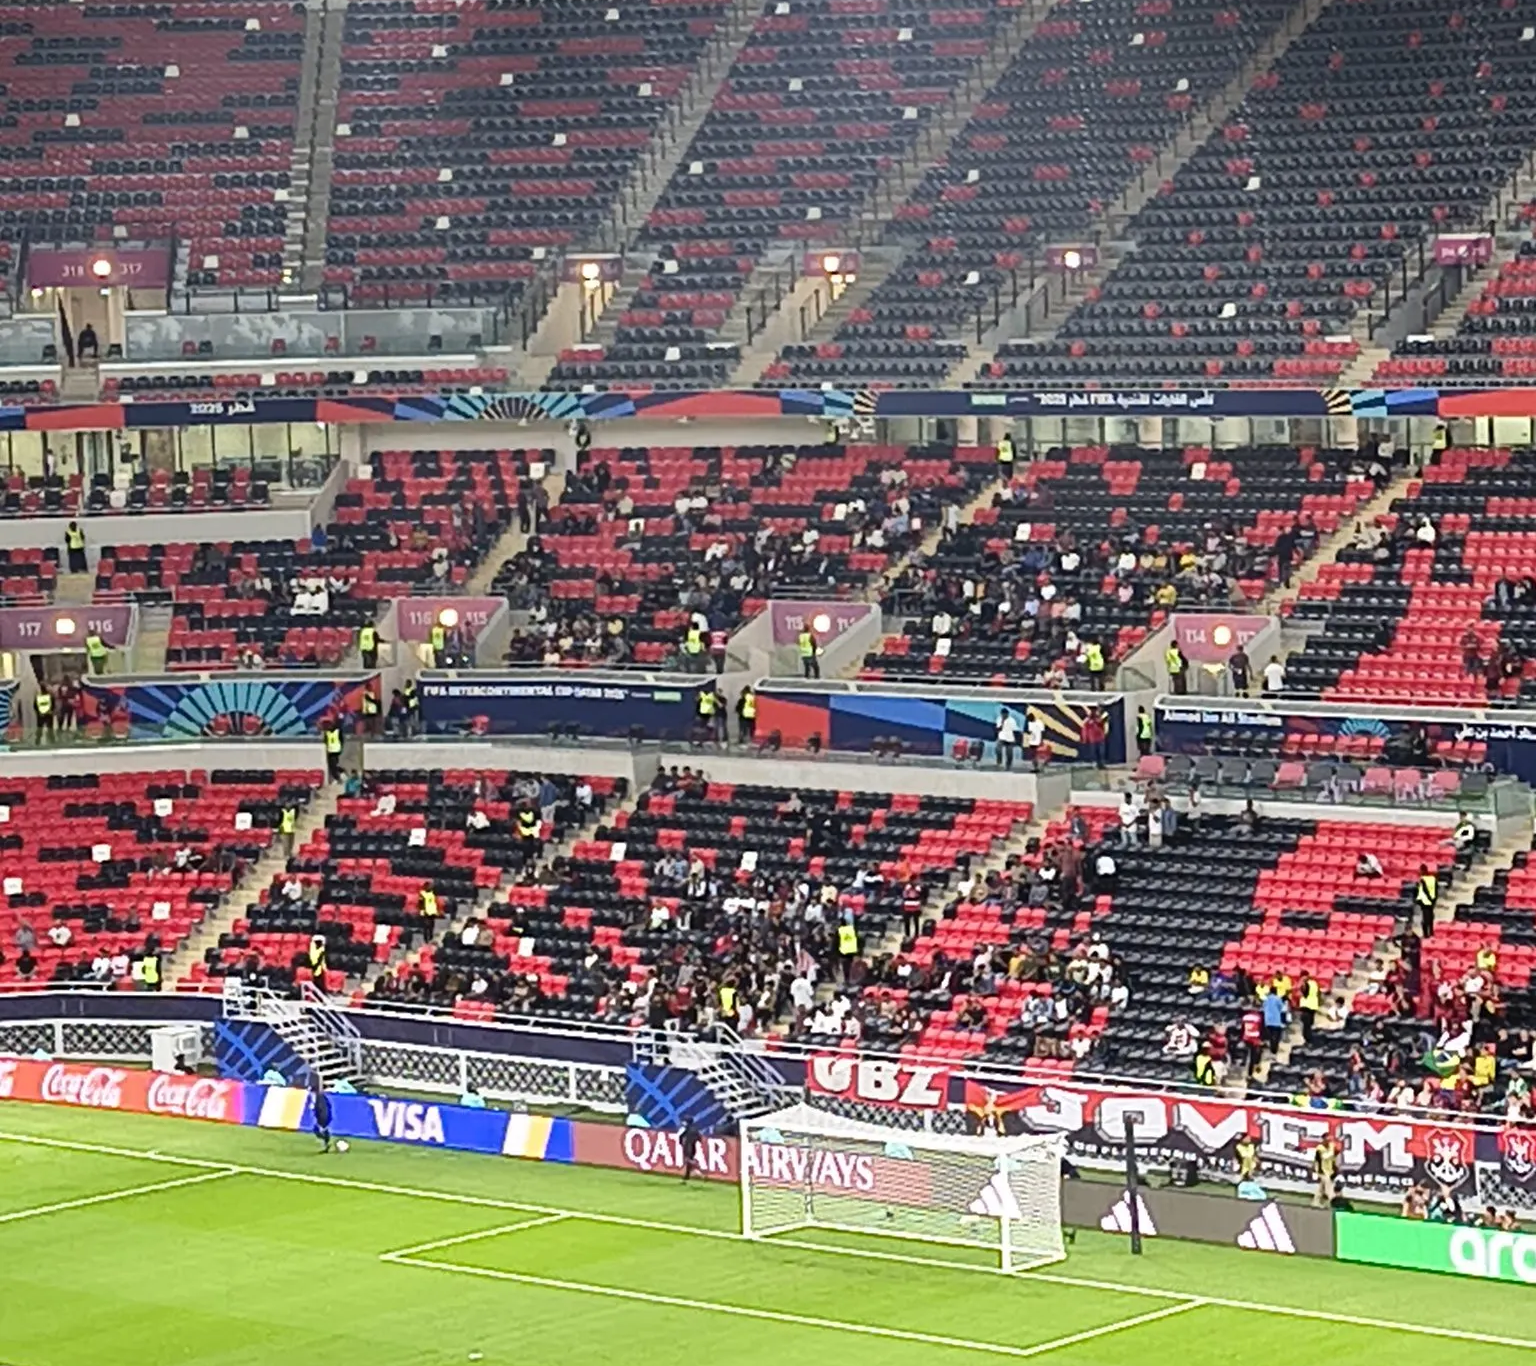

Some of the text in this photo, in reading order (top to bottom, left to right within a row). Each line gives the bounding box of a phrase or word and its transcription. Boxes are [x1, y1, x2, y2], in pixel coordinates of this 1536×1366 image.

[18, 621, 42, 636] 117
[367, 1098, 446, 1143] VISA
[1020, 1087, 1414, 1169] JOVEM
[624, 1124, 874, 1191] QATAR AIRWAYS
